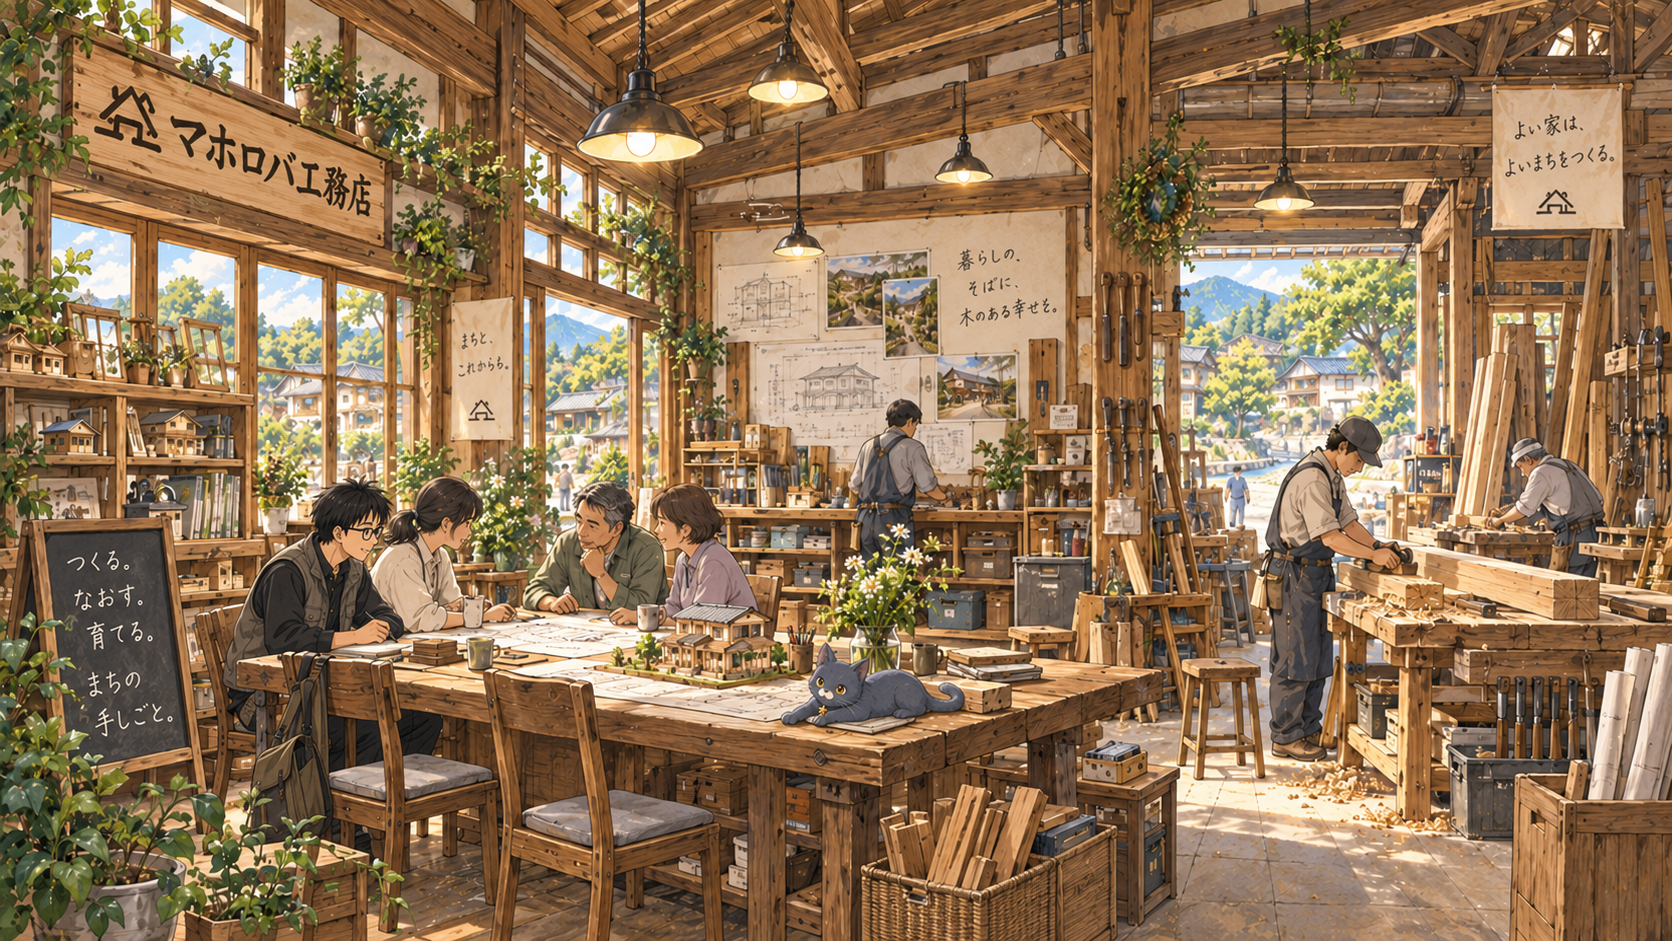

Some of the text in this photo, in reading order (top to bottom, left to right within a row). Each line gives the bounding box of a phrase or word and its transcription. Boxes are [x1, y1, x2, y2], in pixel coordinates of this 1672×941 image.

[1514, 113, 1584, 140] よい家は、
[170, 115, 372, 217] マホロバ工務店
[1504, 144, 1615, 178] よいまちをつくる。
[957, 248, 1020, 271] 暮らしの、
[461, 331, 493, 350] まちと、
[66, 550, 130, 572] つくる。
[73, 583, 144, 611] なおす。
[86, 620, 154, 651] 育てる。
[87, 670, 142, 698] まちの
[94, 702, 174, 737] 手しごと。
